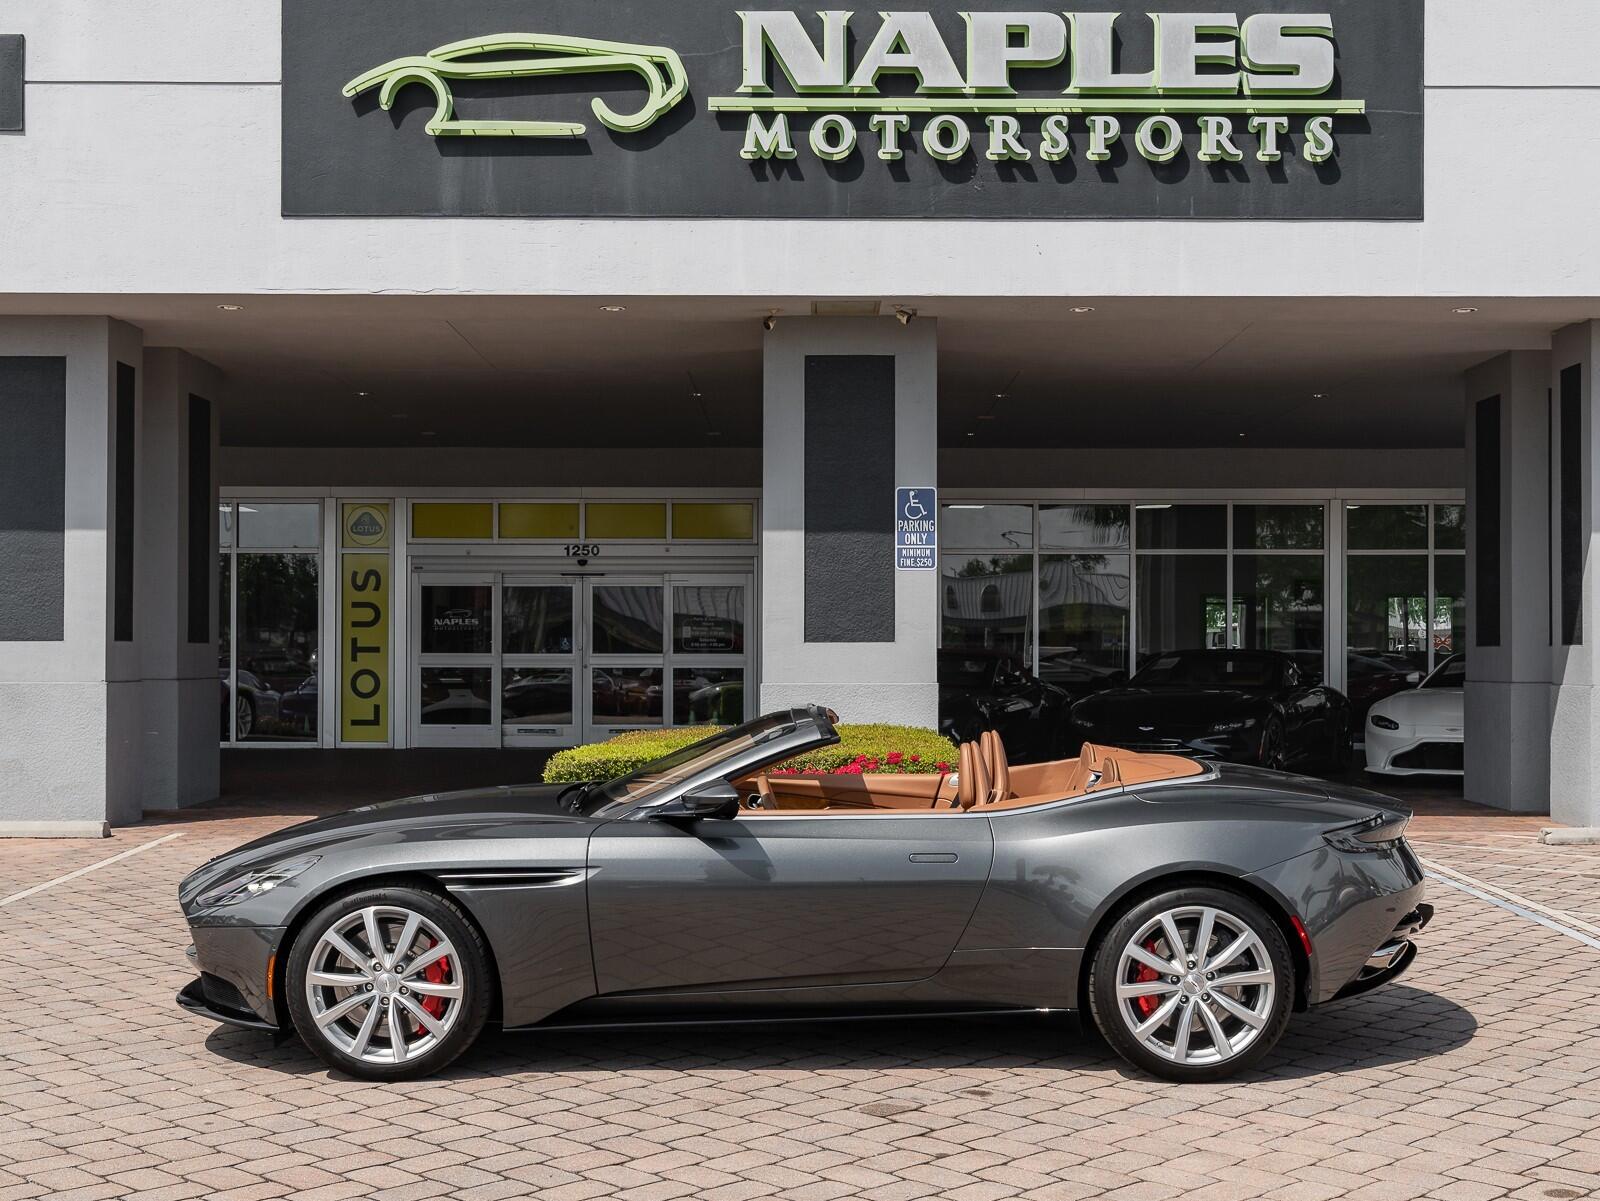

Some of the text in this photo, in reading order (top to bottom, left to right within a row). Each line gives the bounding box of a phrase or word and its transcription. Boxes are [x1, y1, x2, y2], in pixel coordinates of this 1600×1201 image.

[735, 10, 1335, 95] NAPLES
[739, 113, 1335, 163] MOTORSPORTS
[898, 520, 934, 532] PARKING
[905, 533, 927, 545] ONLY
[563, 544, 600, 557] 1250
[902, 548, 931, 557] MINIMUM
[434, 618, 480, 626] NAPLES
[350, 569, 382, 727] LOTUS
